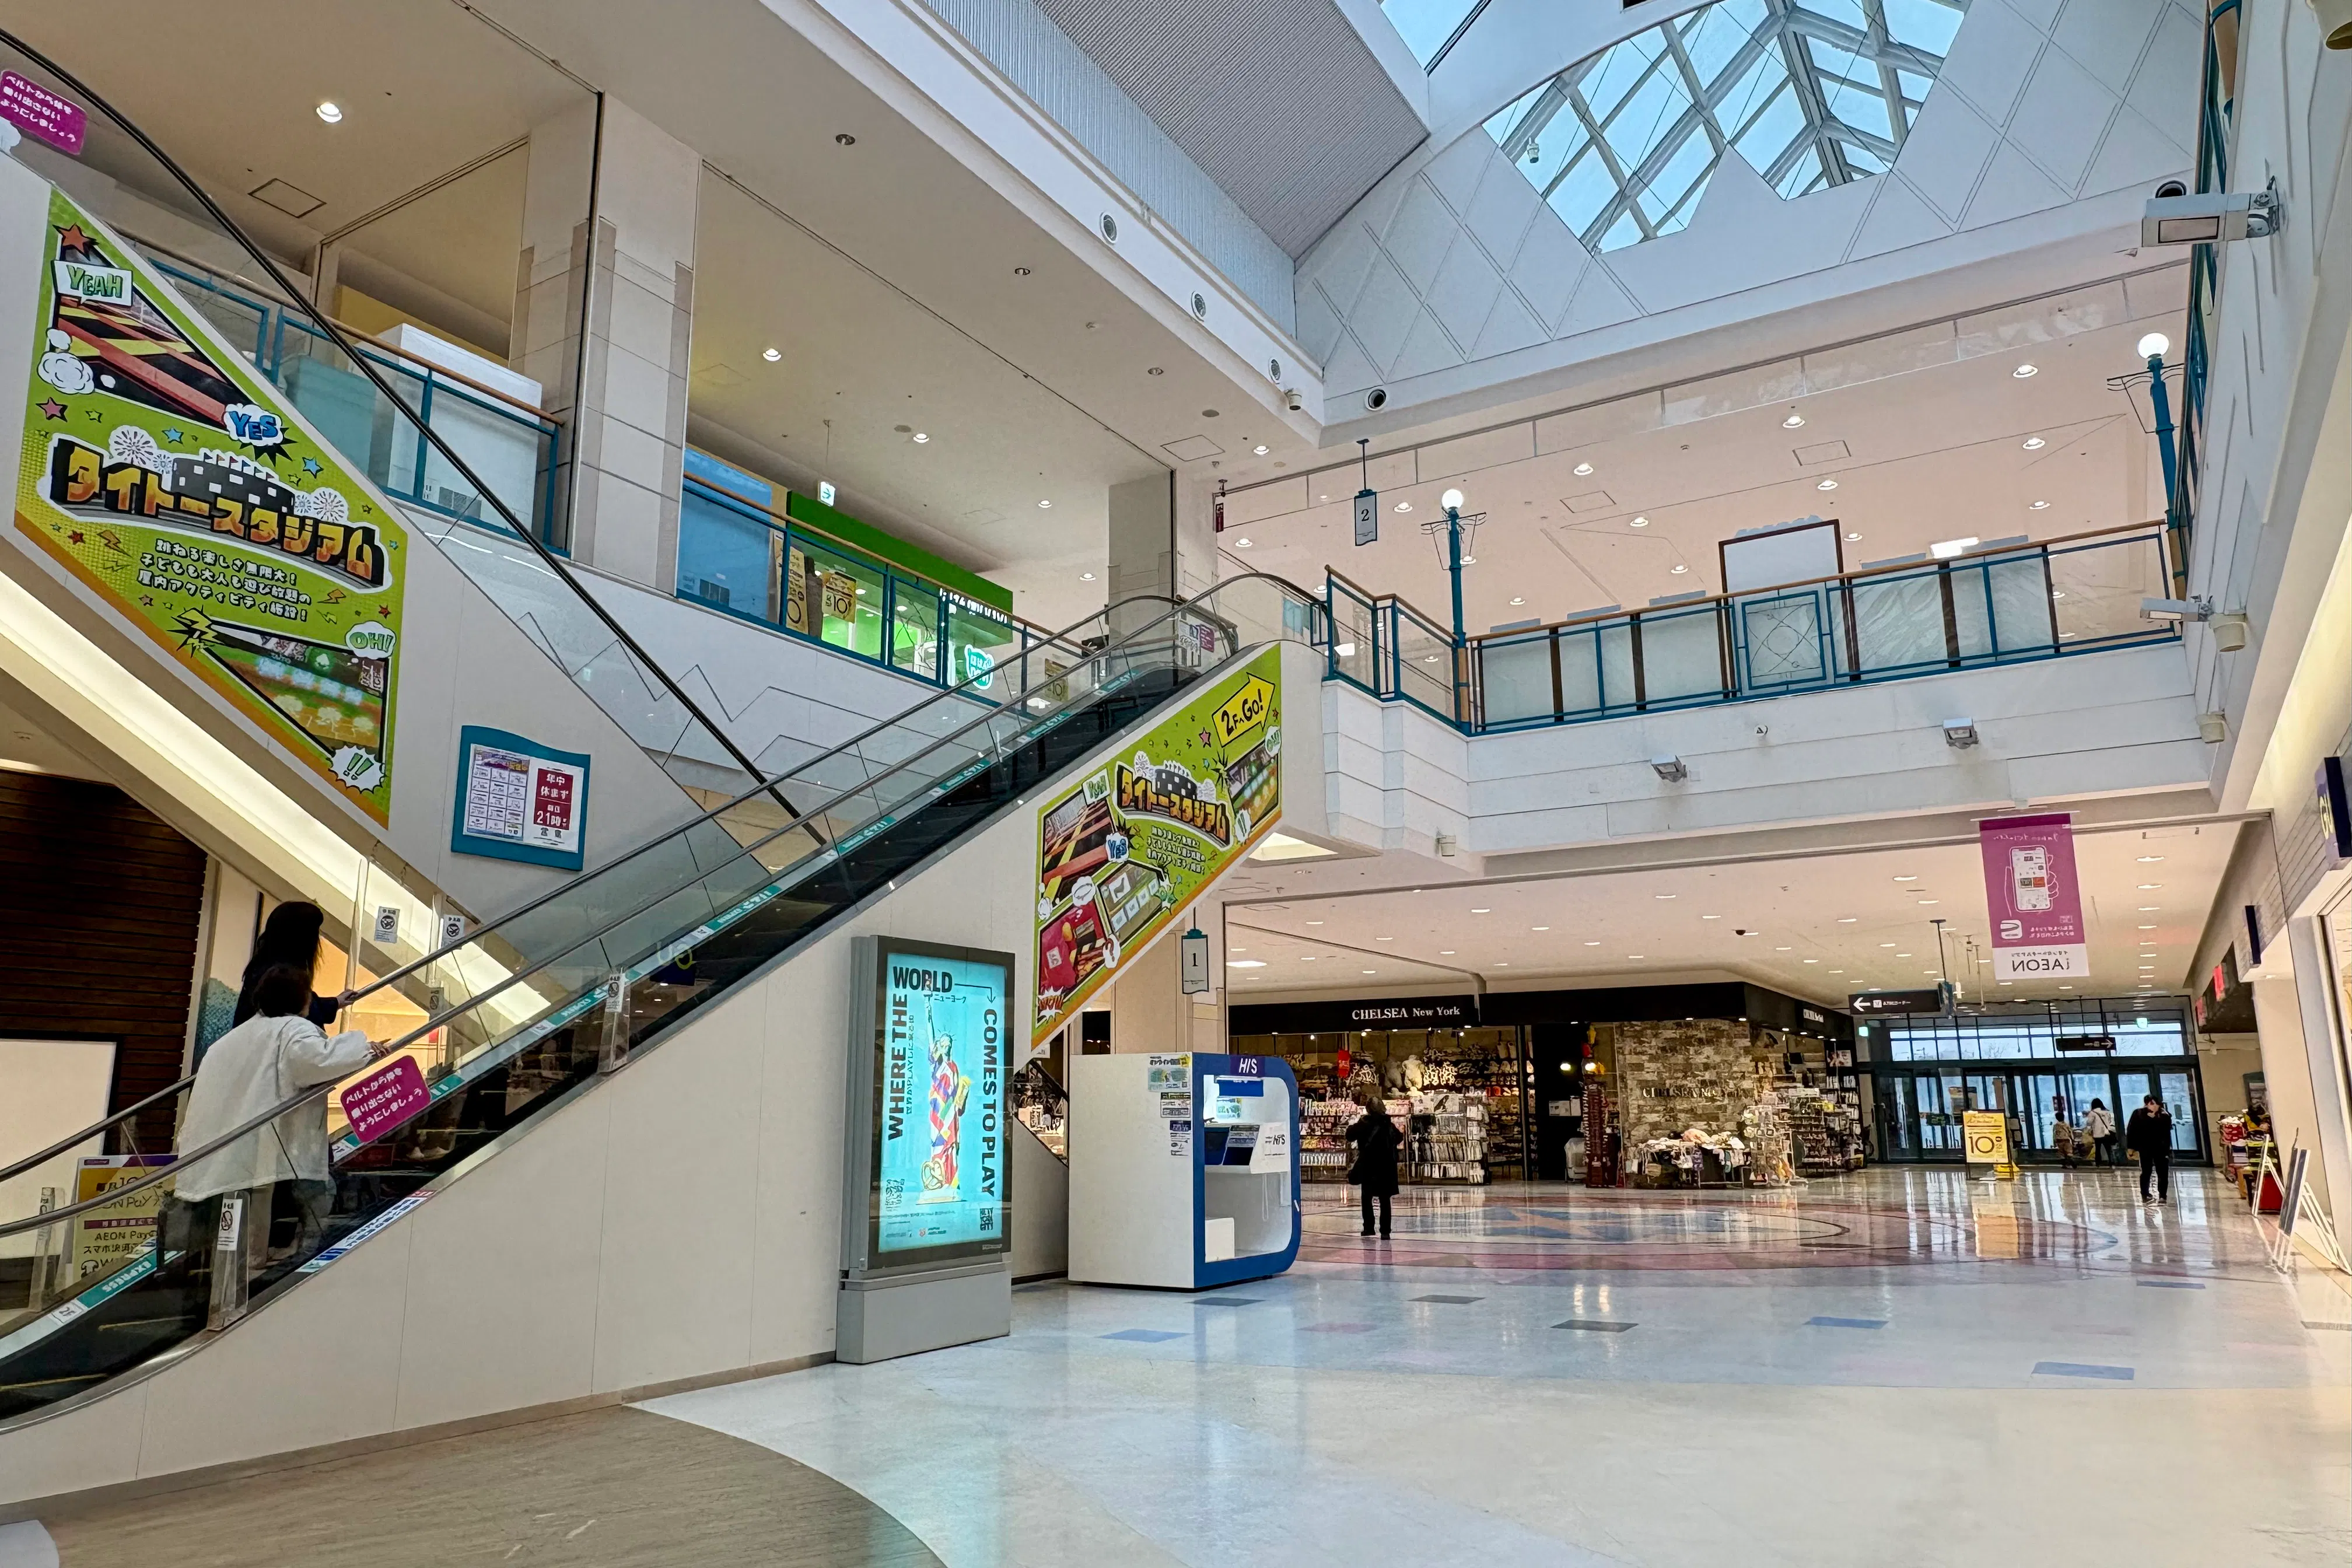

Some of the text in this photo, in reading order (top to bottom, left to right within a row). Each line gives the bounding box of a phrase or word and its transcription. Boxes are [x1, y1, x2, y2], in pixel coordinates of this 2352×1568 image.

[66, 264, 123, 298] YEAH
[227, 410, 278, 441] YES
[1361, 509, 1369, 522] 2
[349, 632, 393, 652] OH!
[1192, 953, 1199, 967] 1
[893, 966, 953, 993] WORLD
[1352, 1006, 1460, 1020] CHELSEA New York
[888, 993, 908, 1141] WHERE THE
[1238, 1058, 1258, 1074] HIS
[981, 1009, 998, 1196] COMES TO PLAY
[94, 1231, 126, 1241] AEON
[102, 1261, 152, 1293] EXPRESS
